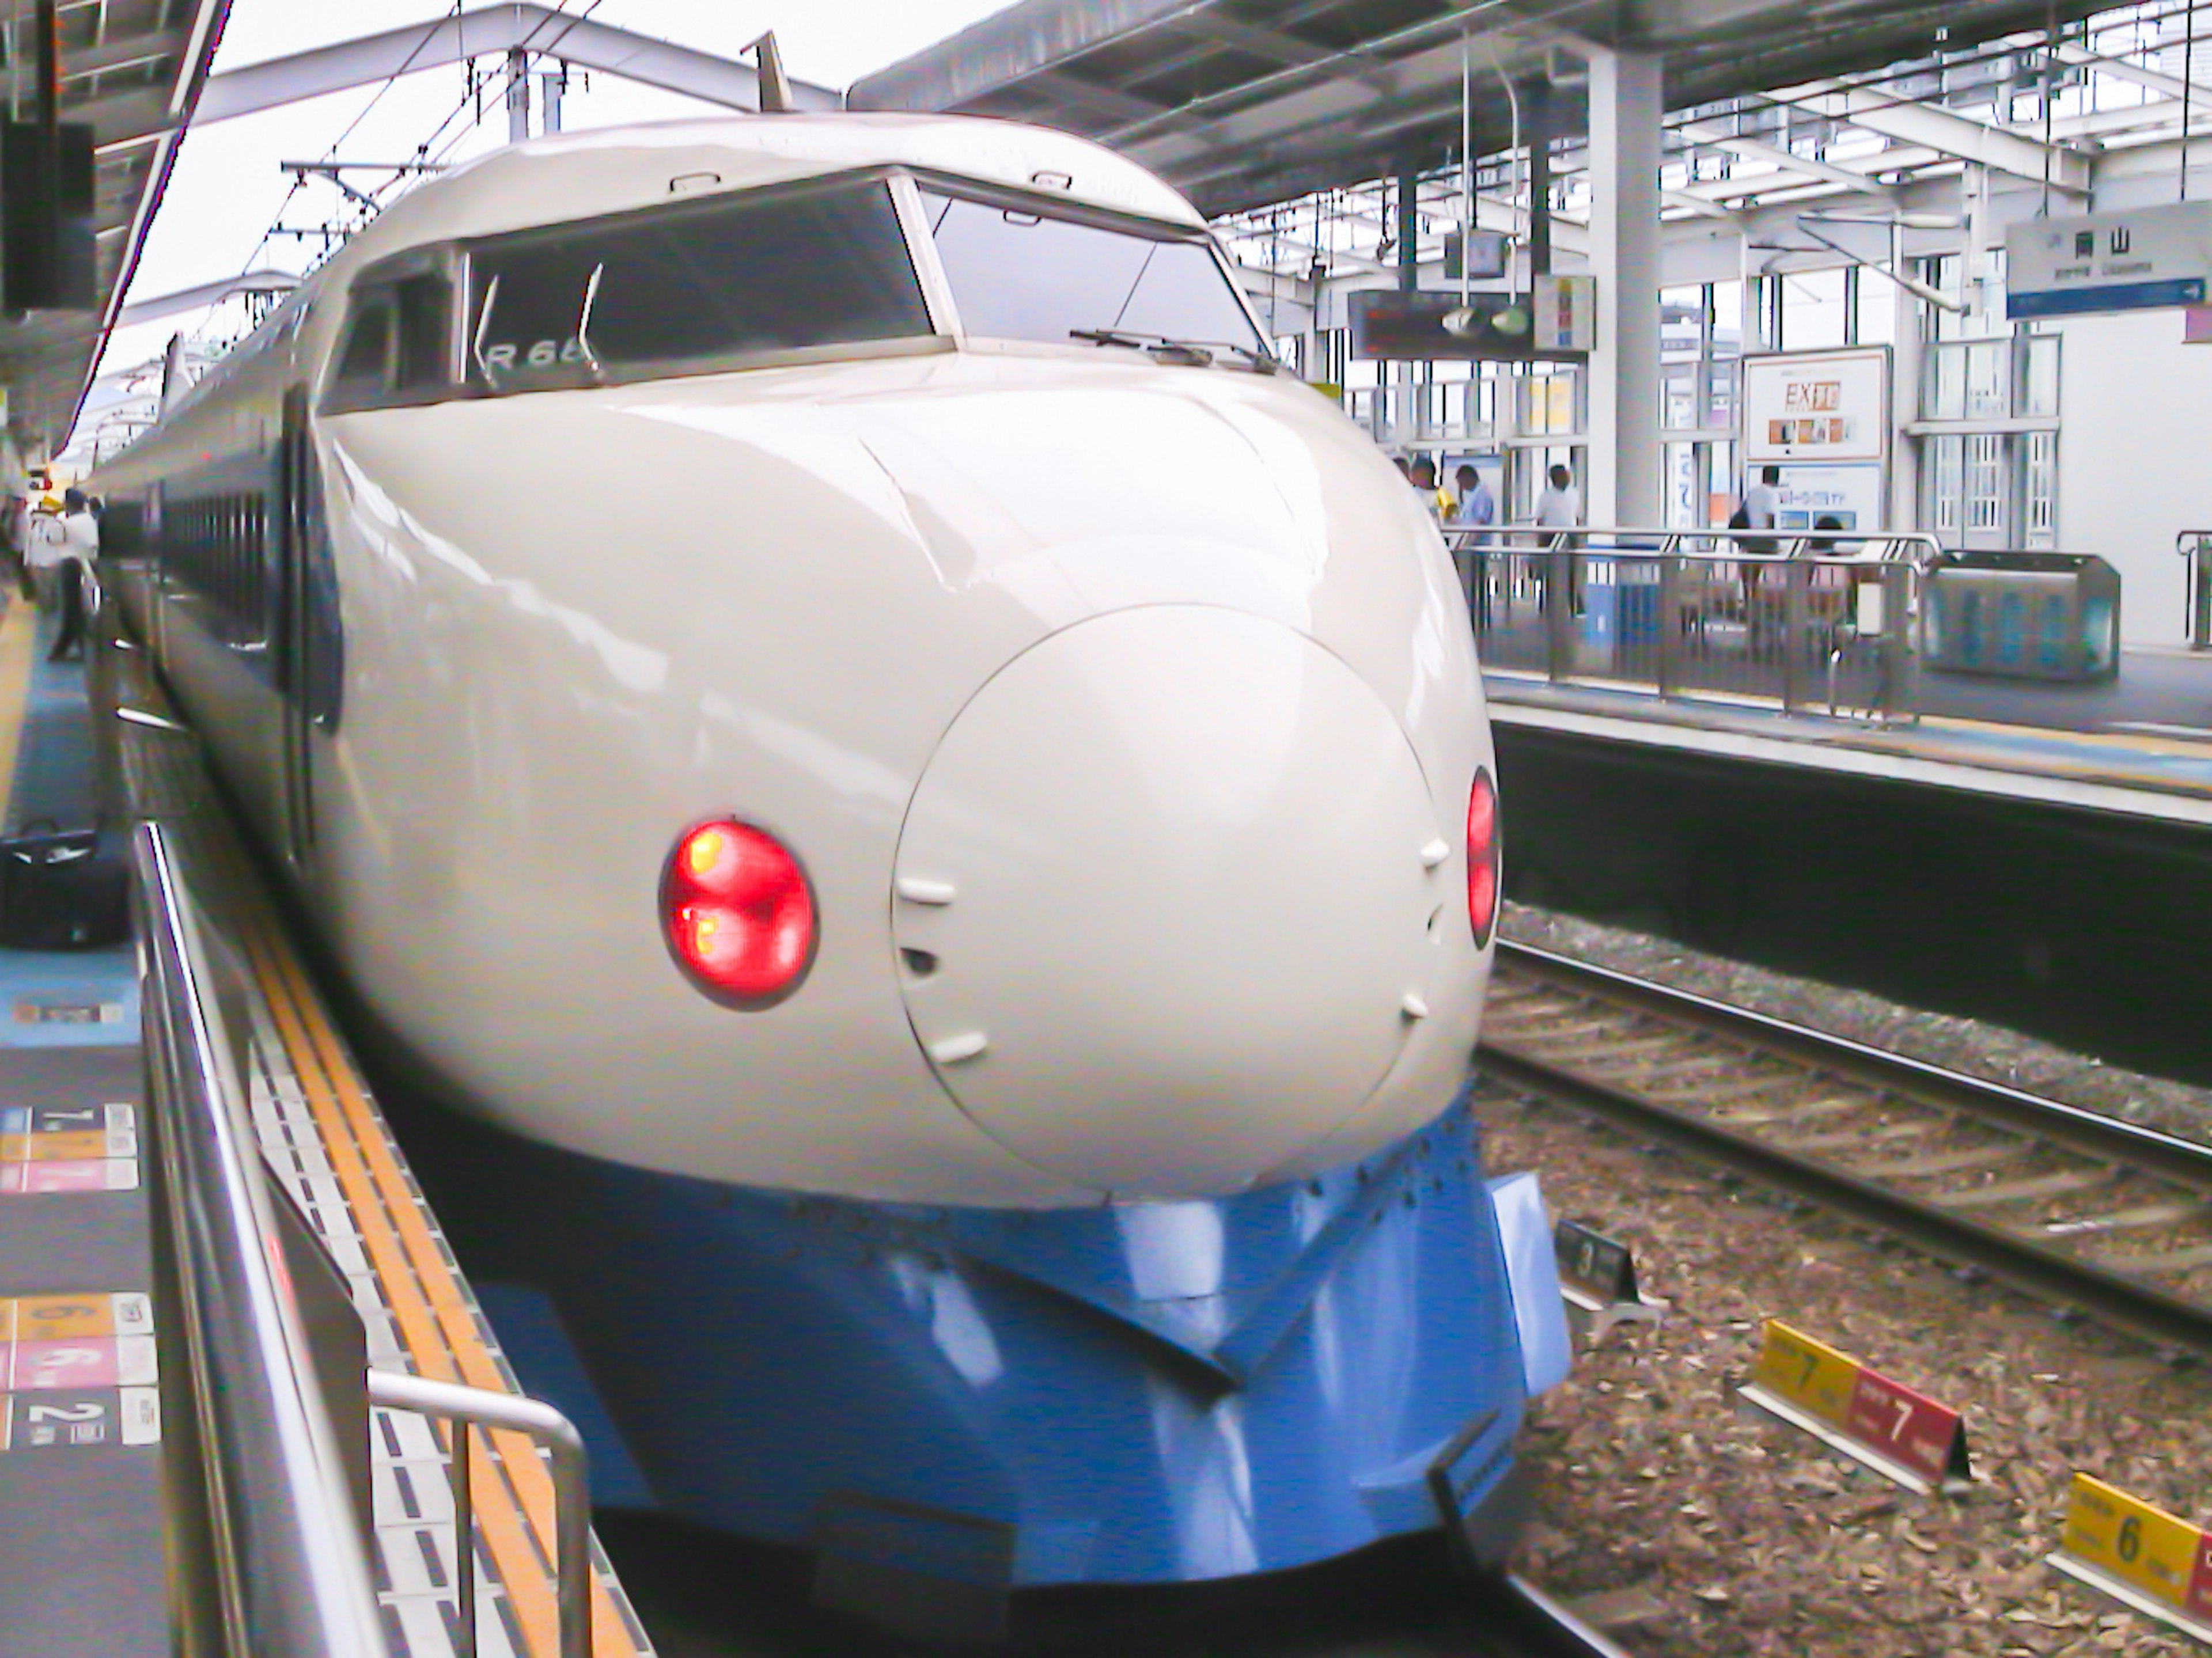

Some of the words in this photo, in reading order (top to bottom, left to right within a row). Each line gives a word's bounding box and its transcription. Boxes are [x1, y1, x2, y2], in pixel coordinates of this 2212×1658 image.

[1798, 1352, 1820, 1390] 7
[29, 1402, 105, 1422] 2
[1891, 1398, 1914, 1443] 7
[2119, 1513, 2141, 1563] 6
